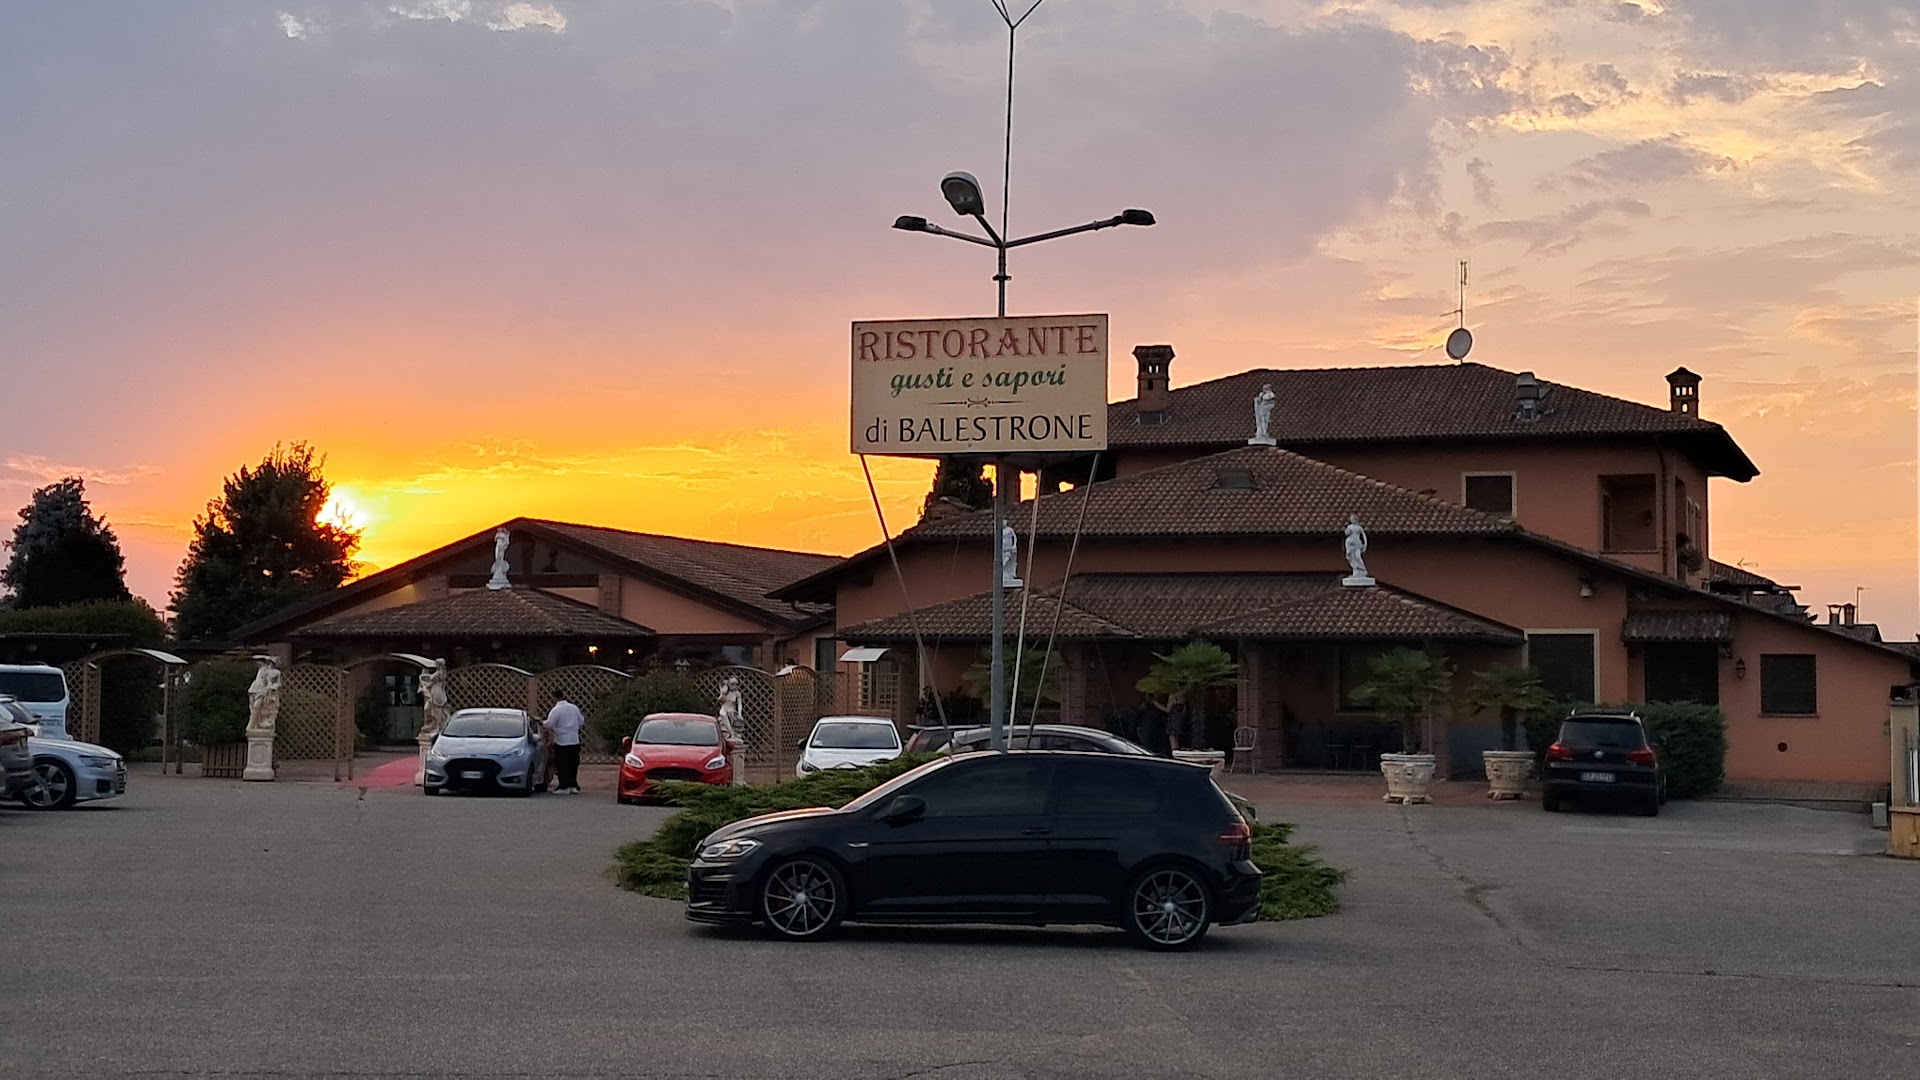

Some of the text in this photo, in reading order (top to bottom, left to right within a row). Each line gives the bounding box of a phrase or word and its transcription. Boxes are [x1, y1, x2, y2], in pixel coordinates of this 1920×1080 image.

[858, 325, 1098, 361] RISTORANTE
[890, 364, 1067, 397] gusti e sapori
[865, 414, 1093, 443] di BALESTRONE
